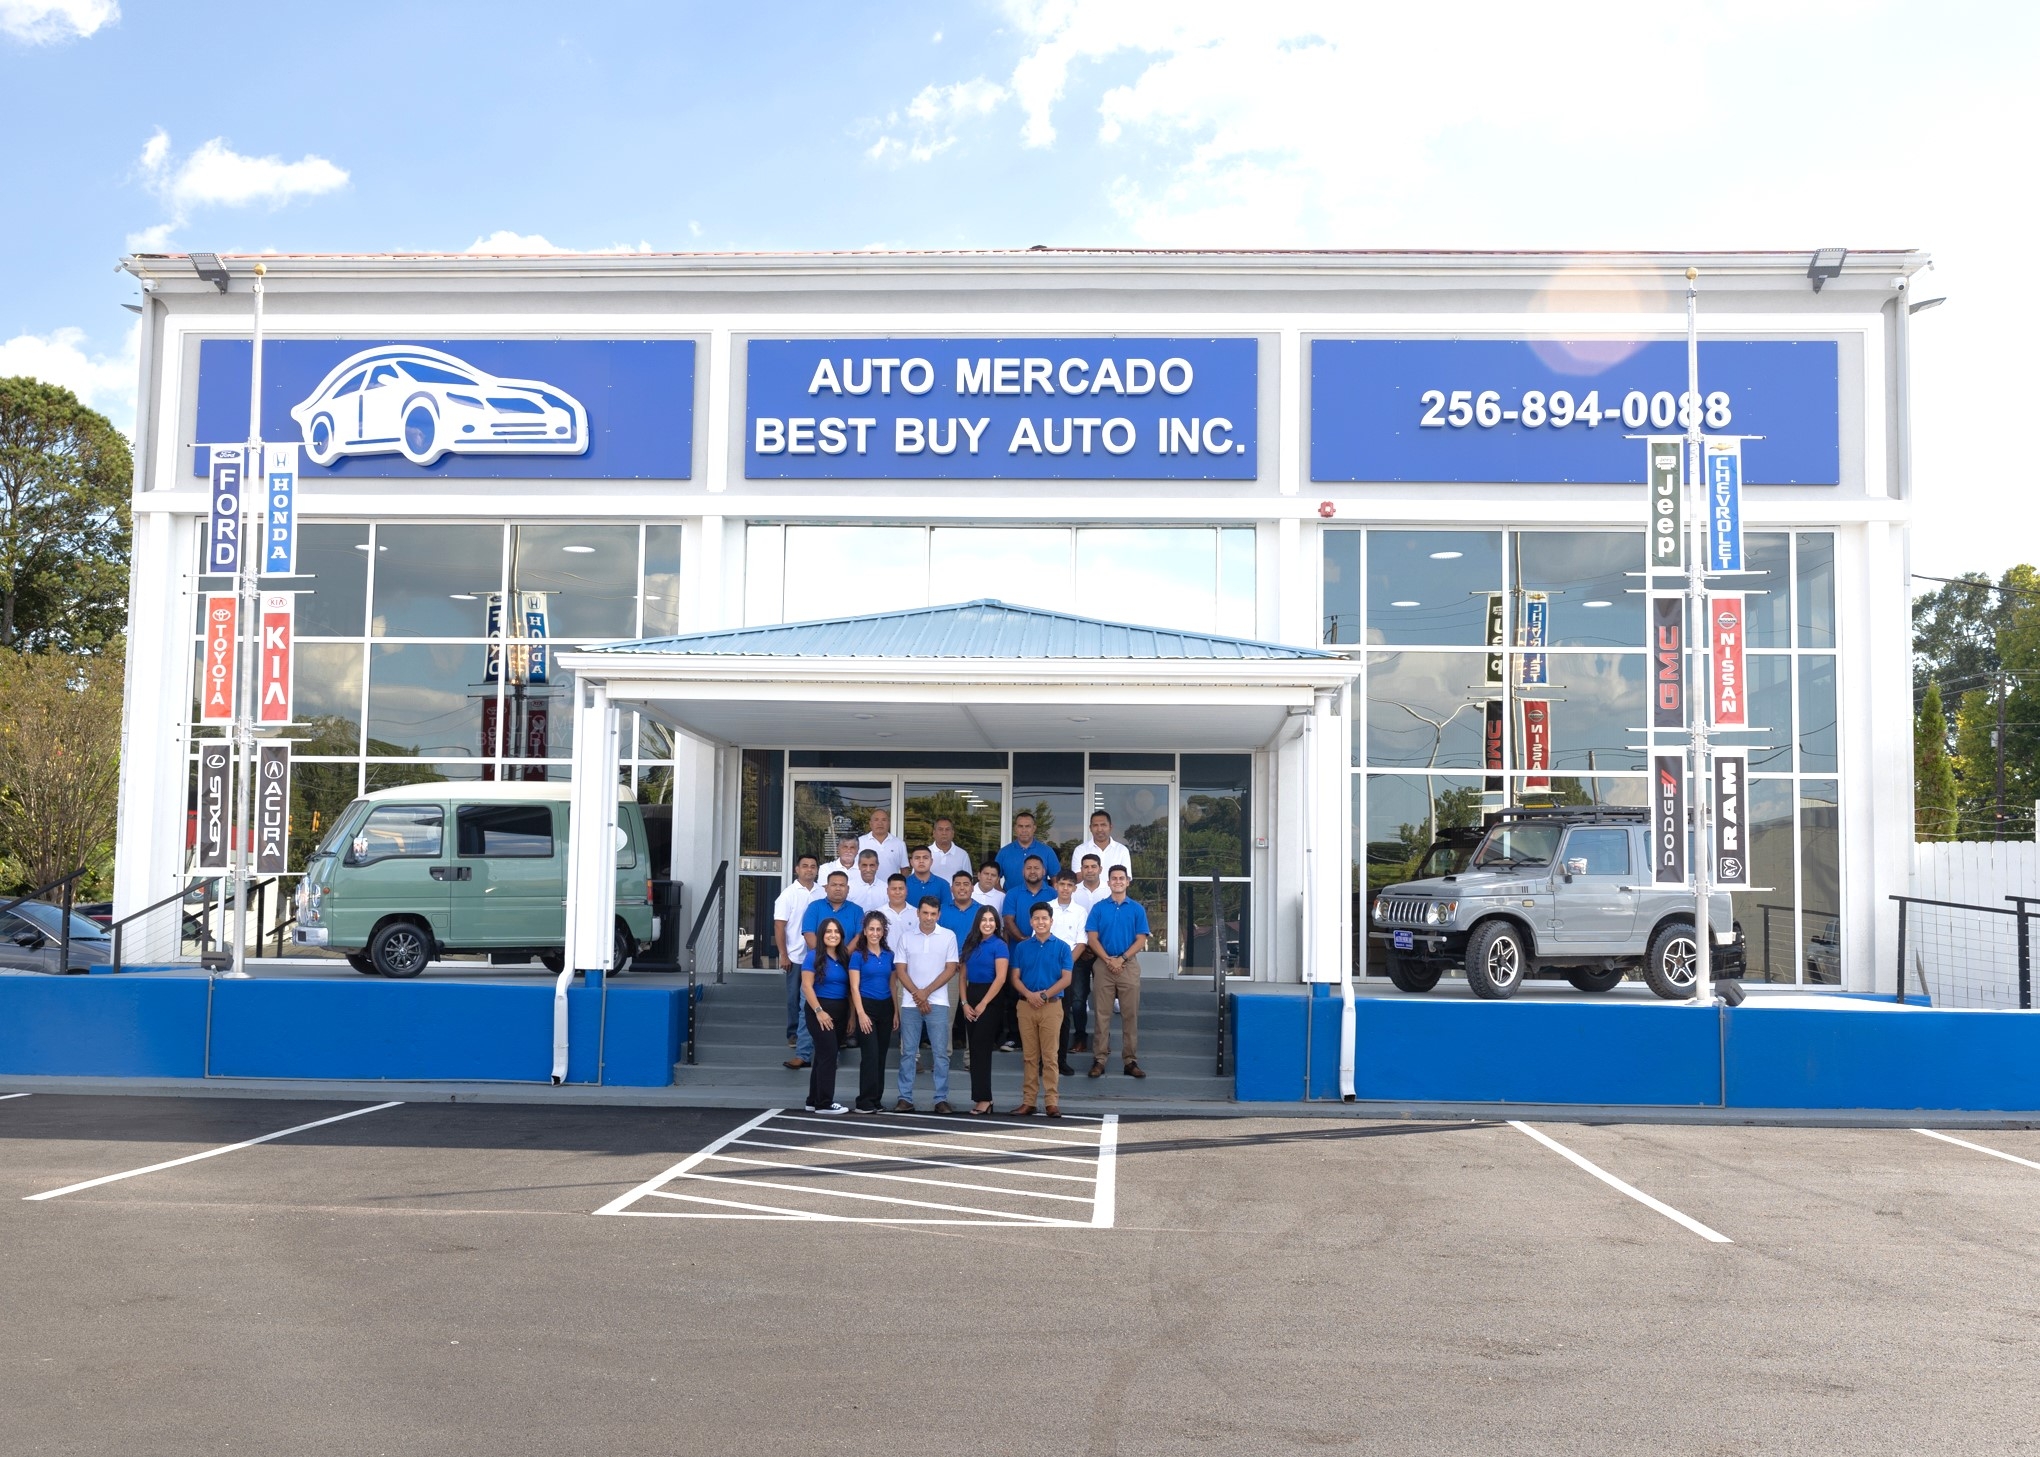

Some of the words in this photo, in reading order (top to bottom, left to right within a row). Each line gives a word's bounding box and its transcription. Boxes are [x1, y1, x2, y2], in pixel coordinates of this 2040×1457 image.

[808, 357, 934, 395] AUTO
[956, 357, 1194, 395] MERCADO
[1419, 389, 1732, 429] 256-894-0088
[755, 417, 876, 455] BEST
[895, 417, 990, 455] BUY
[1008, 417, 1136, 455] AUTO
[1158, 417, 1246, 455] INC.
[216, 469, 238, 565] FORD
[270, 478, 289, 559] HONDA
[1656, 474, 1676, 558] Jeep
[1715, 456, 1732, 569] CHEVROLET
[210, 624, 228, 705] TOYOTA
[264, 626, 287, 705] KIA
[1659, 626, 1680, 709] GMC
[1720, 633, 1737, 713] NISSAN
[208, 775, 222, 857] LEXUS
[261, 782, 283, 857] ACURA
[1663, 783, 1675, 866] DODGE
[1721, 762, 1738, 850] RAM
